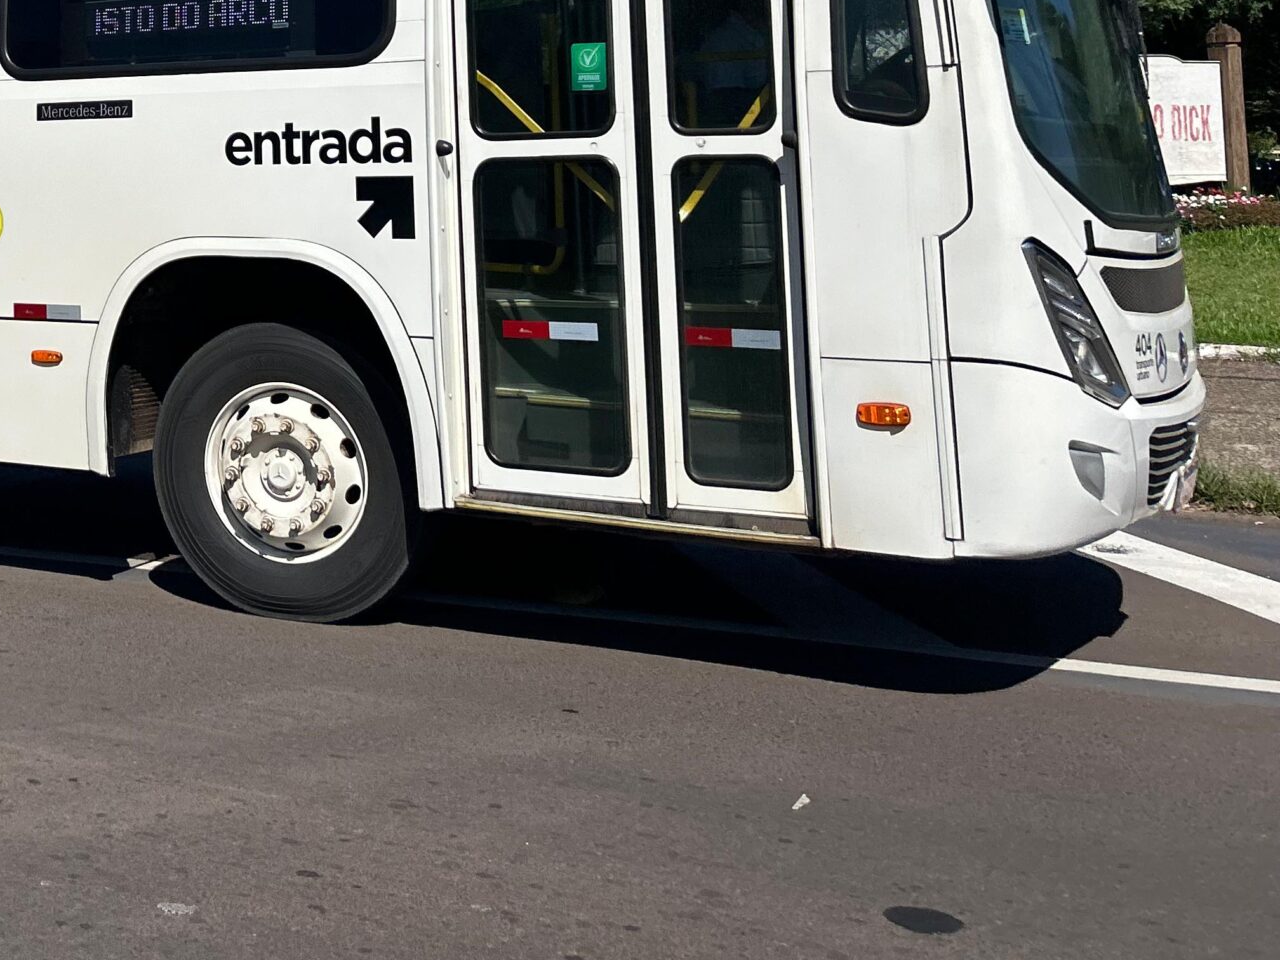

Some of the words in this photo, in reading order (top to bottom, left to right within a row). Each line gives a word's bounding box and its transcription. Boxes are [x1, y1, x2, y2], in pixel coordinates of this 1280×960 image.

[163, 1, 200, 31] DO
[41, 103, 129, 119] Mercedes-Benz
[1171, 104, 1213, 142] DICK
[224, 116, 413, 166] entrada
[1135, 332, 1152, 357] 404
